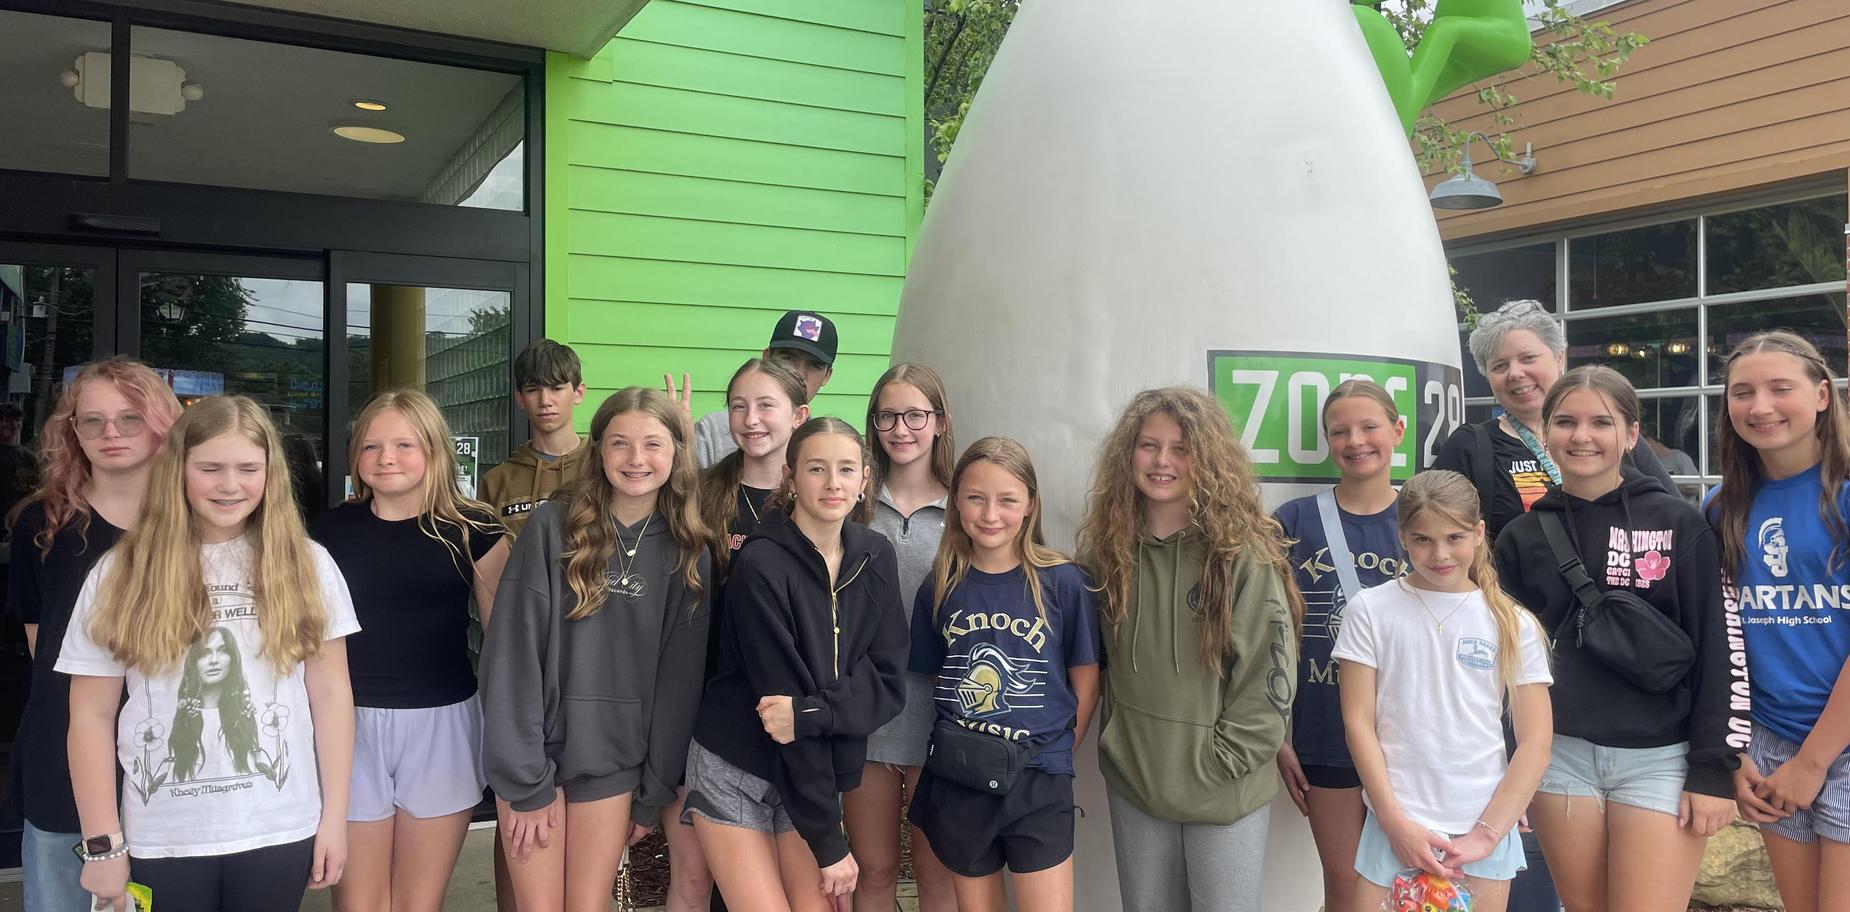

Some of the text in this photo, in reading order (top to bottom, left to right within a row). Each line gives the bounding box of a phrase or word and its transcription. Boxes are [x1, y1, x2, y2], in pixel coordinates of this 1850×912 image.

[1232, 370, 1407, 467] ZOE
[456, 442, 471, 455] 28
[1508, 460, 1537, 474] JUST
[1607, 550, 1631, 567] DC
[225, 606, 258, 619] WELL
[1748, 616, 1775, 626] Joseph
[1777, 616, 1802, 627] High
[1803, 615, 1832, 625] School
[942, 609, 1046, 653] Knoch
